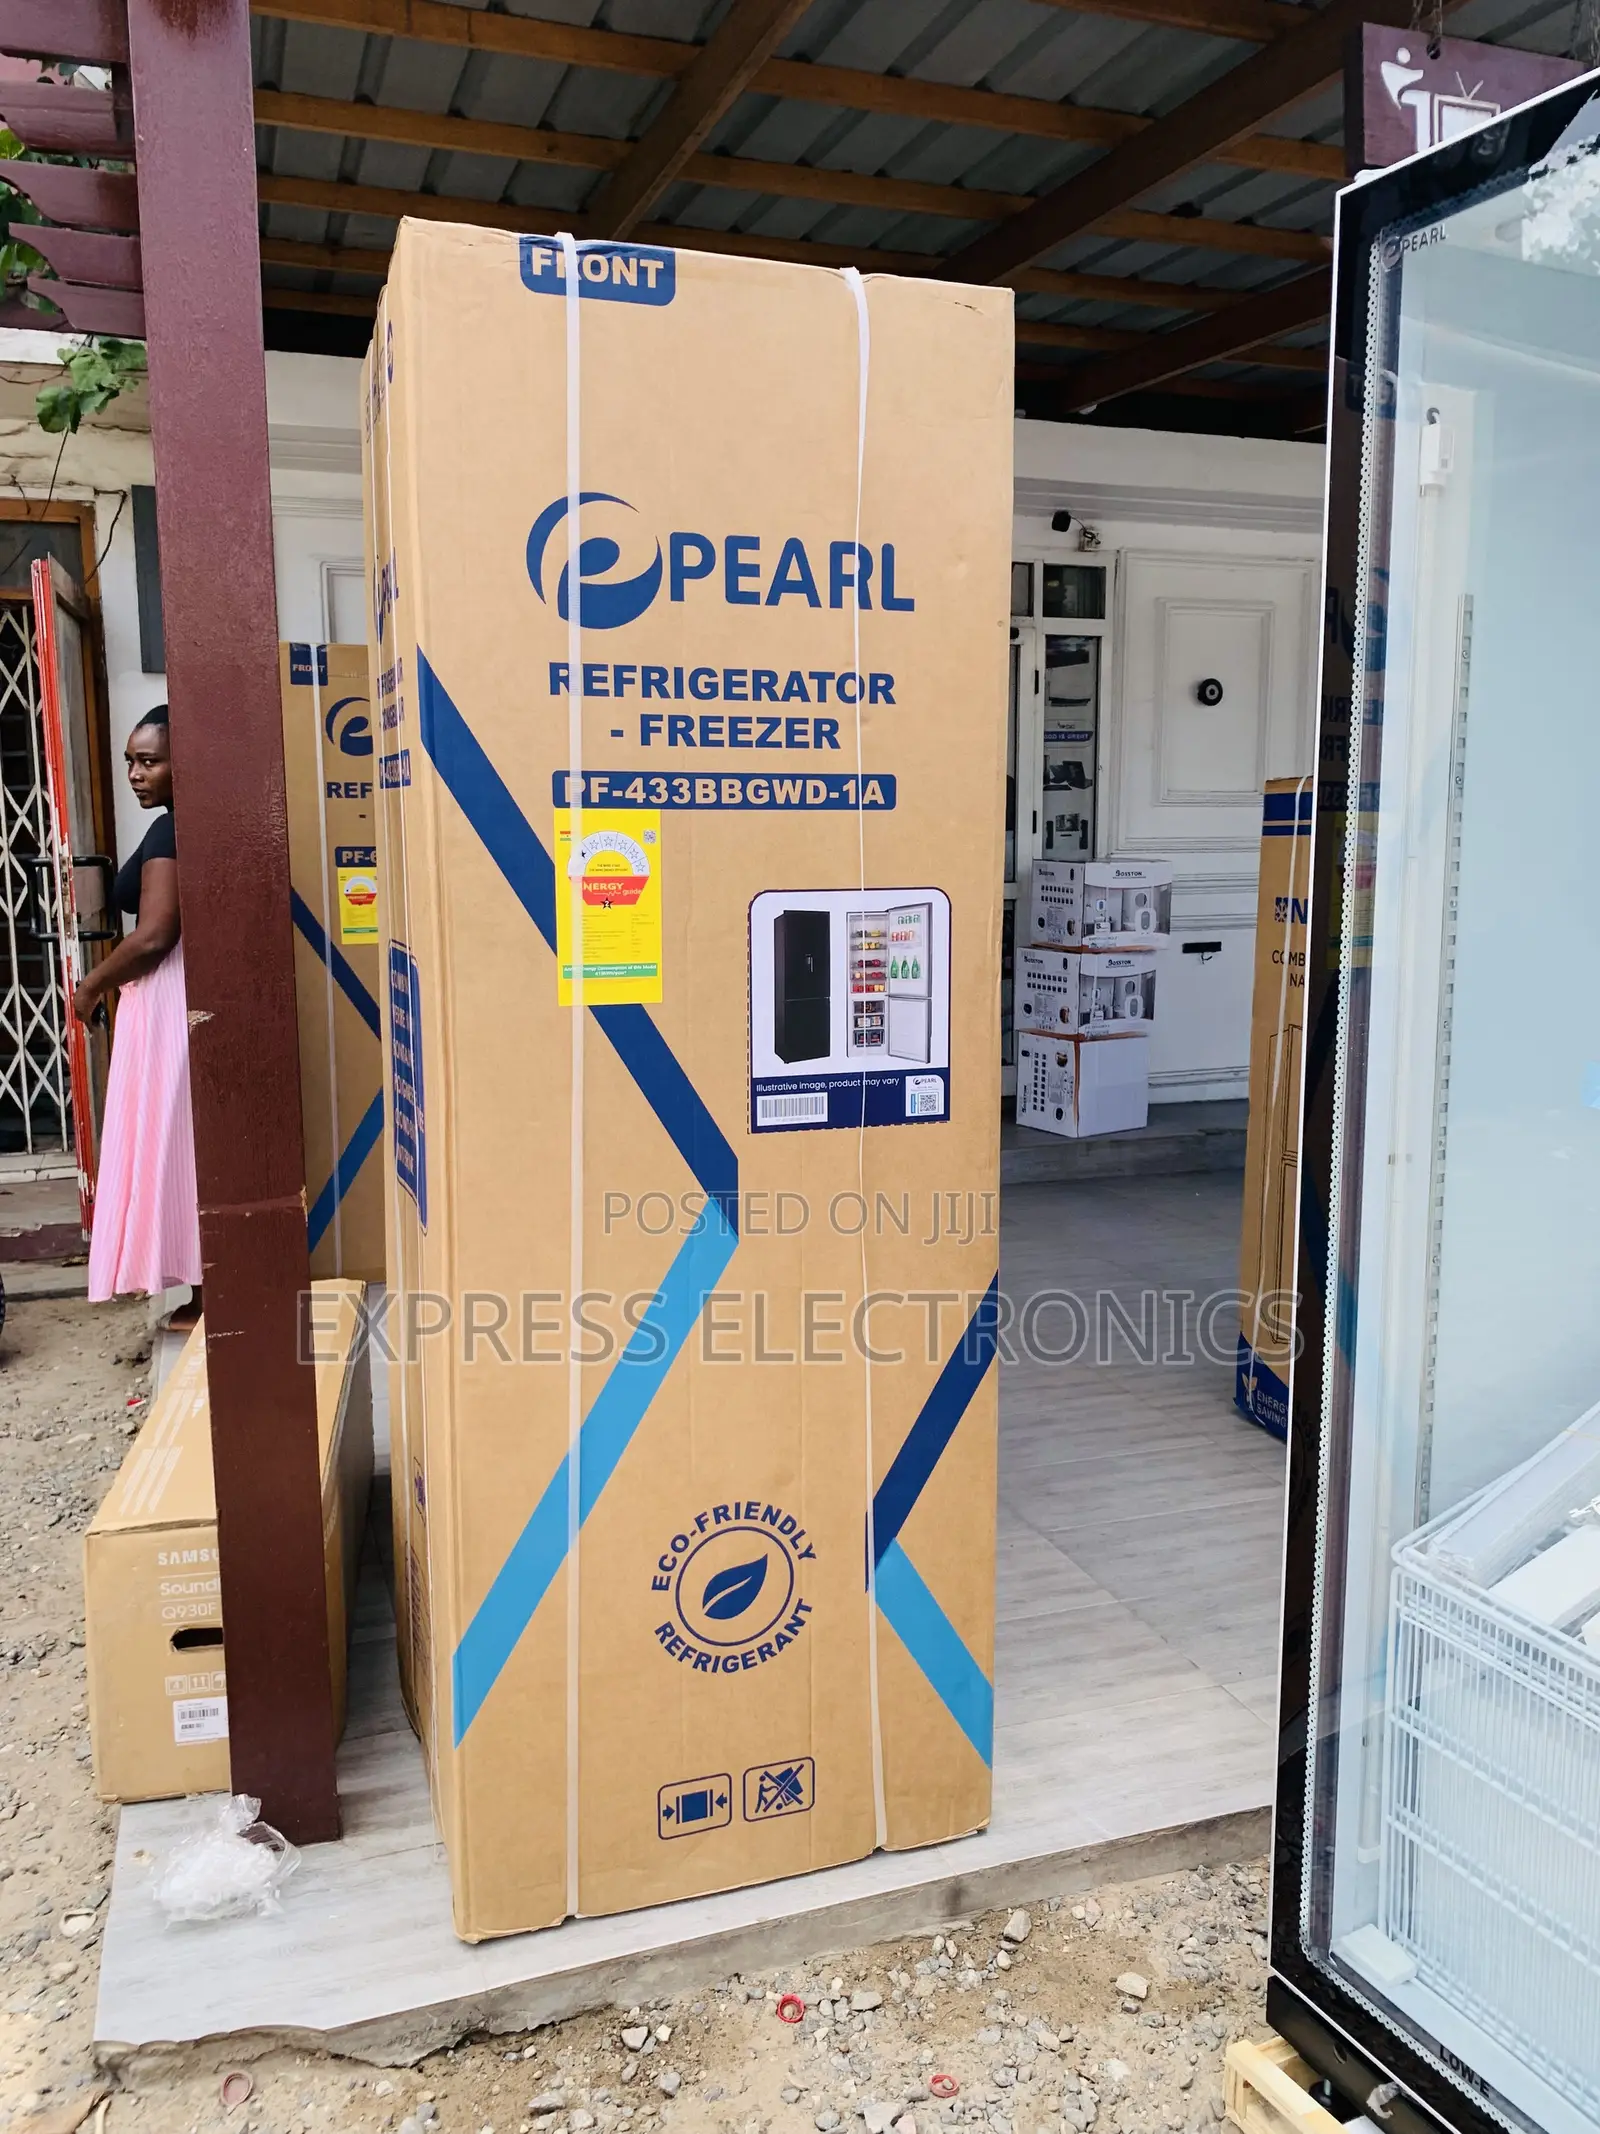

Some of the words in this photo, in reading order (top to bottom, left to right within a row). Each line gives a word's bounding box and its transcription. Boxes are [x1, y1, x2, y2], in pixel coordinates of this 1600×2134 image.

[1402, 223, 1447, 251] PEARL
[669, 531, 915, 612] PEARL
[292, 664, 325, 673] FROT
[549, 662, 896, 705] REFRIGERATOR
[640, 713, 841, 750] FREEZER
[564, 776, 885, 805] PF-433BBGWD-1A
[583, 881, 624, 893] NERGY
[1115, 869, 1143, 877] BOSSTON
[756, 1082, 798, 1092] Illustrative
[829, 1079, 861, 1090] product
[863, 1078, 880, 1087] may
[882, 1077, 900, 1086] vary
[651, 1501, 817, 1592] ECO-FRIENDLY
[161, 1601, 218, 1620] Q930F
[654, 1598, 813, 1674] REFRIGERANT
[1440, 2044, 1490, 2098] LOW-E
